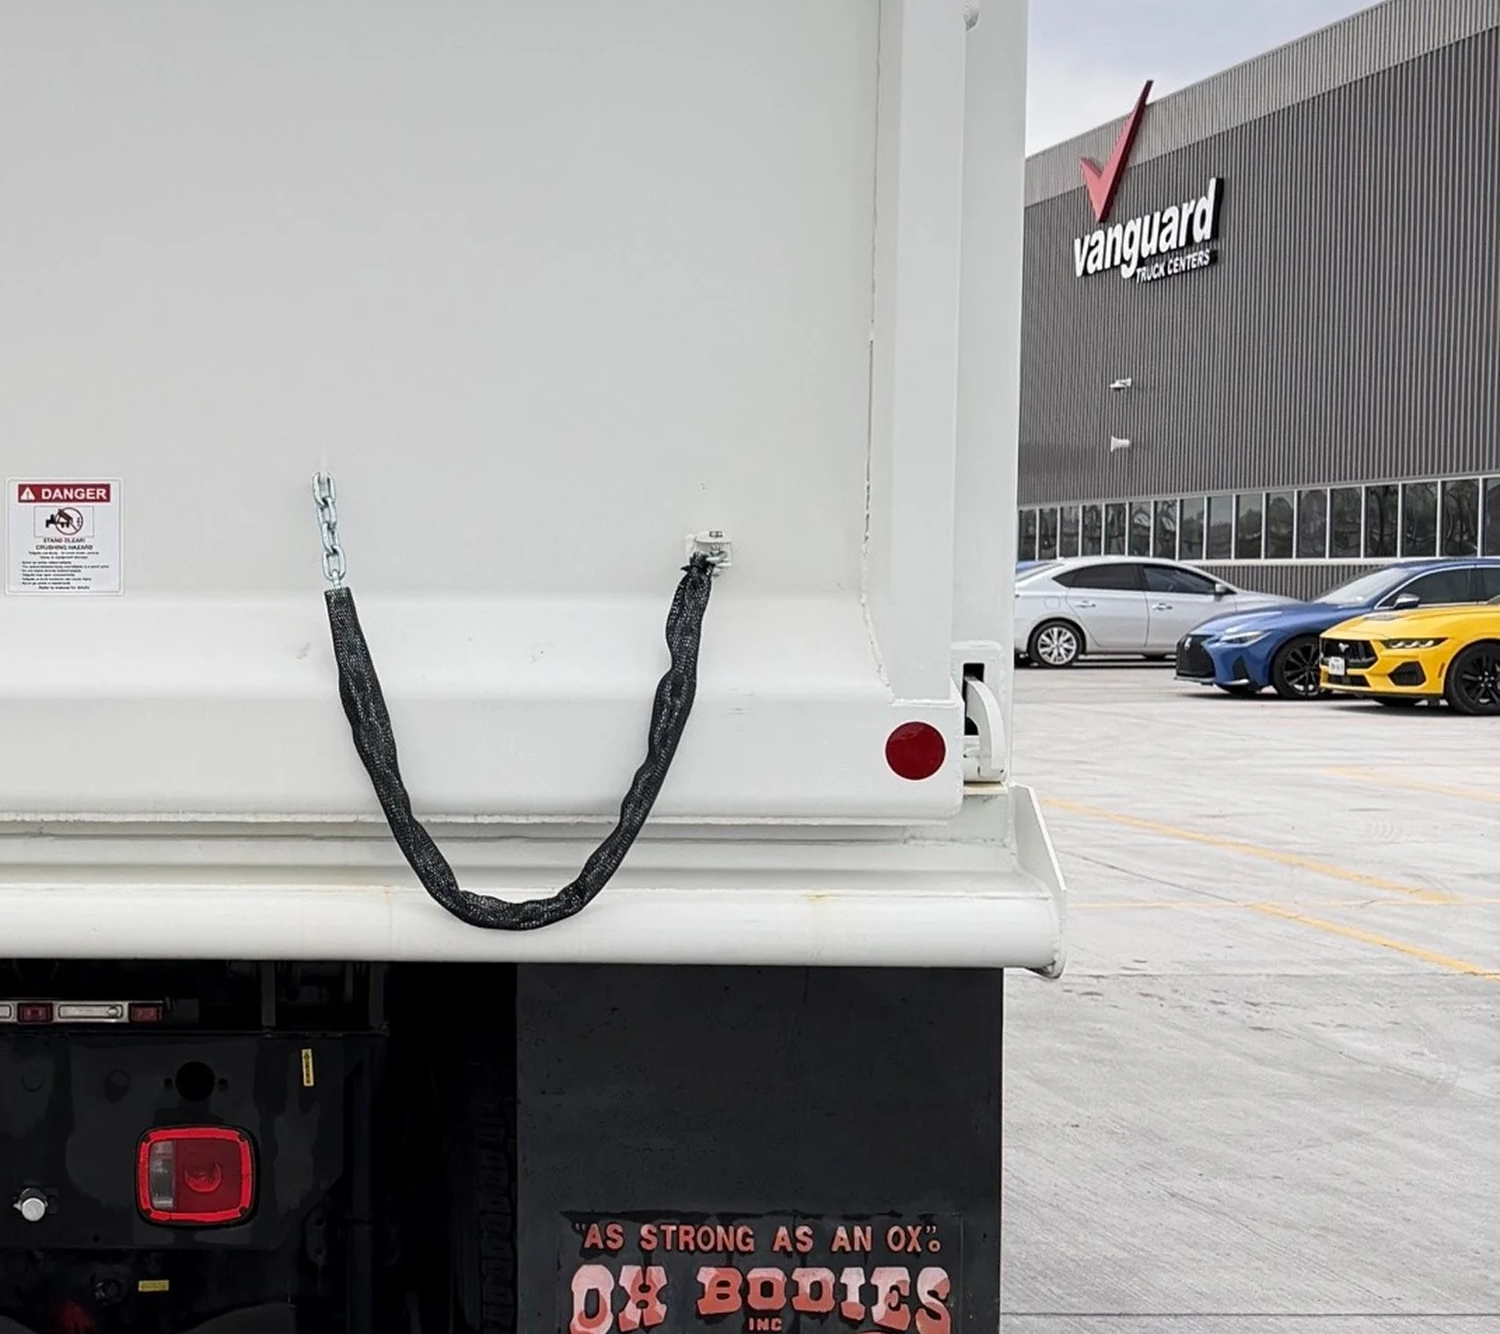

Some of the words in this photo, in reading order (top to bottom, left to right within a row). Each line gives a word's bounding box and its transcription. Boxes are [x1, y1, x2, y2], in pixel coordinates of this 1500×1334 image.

[1074, 177, 1217, 279] vanguard
[1136, 262, 1165, 284] TRUCK
[1167, 248, 1210, 276] CENTERS
[41, 488, 107, 500] DANGER
[639, 1223, 755, 1253] STRONG
[773, 1224, 814, 1253] AS
[831, 1225, 872, 1253] AN
[748, 1318, 783, 1332] INC
